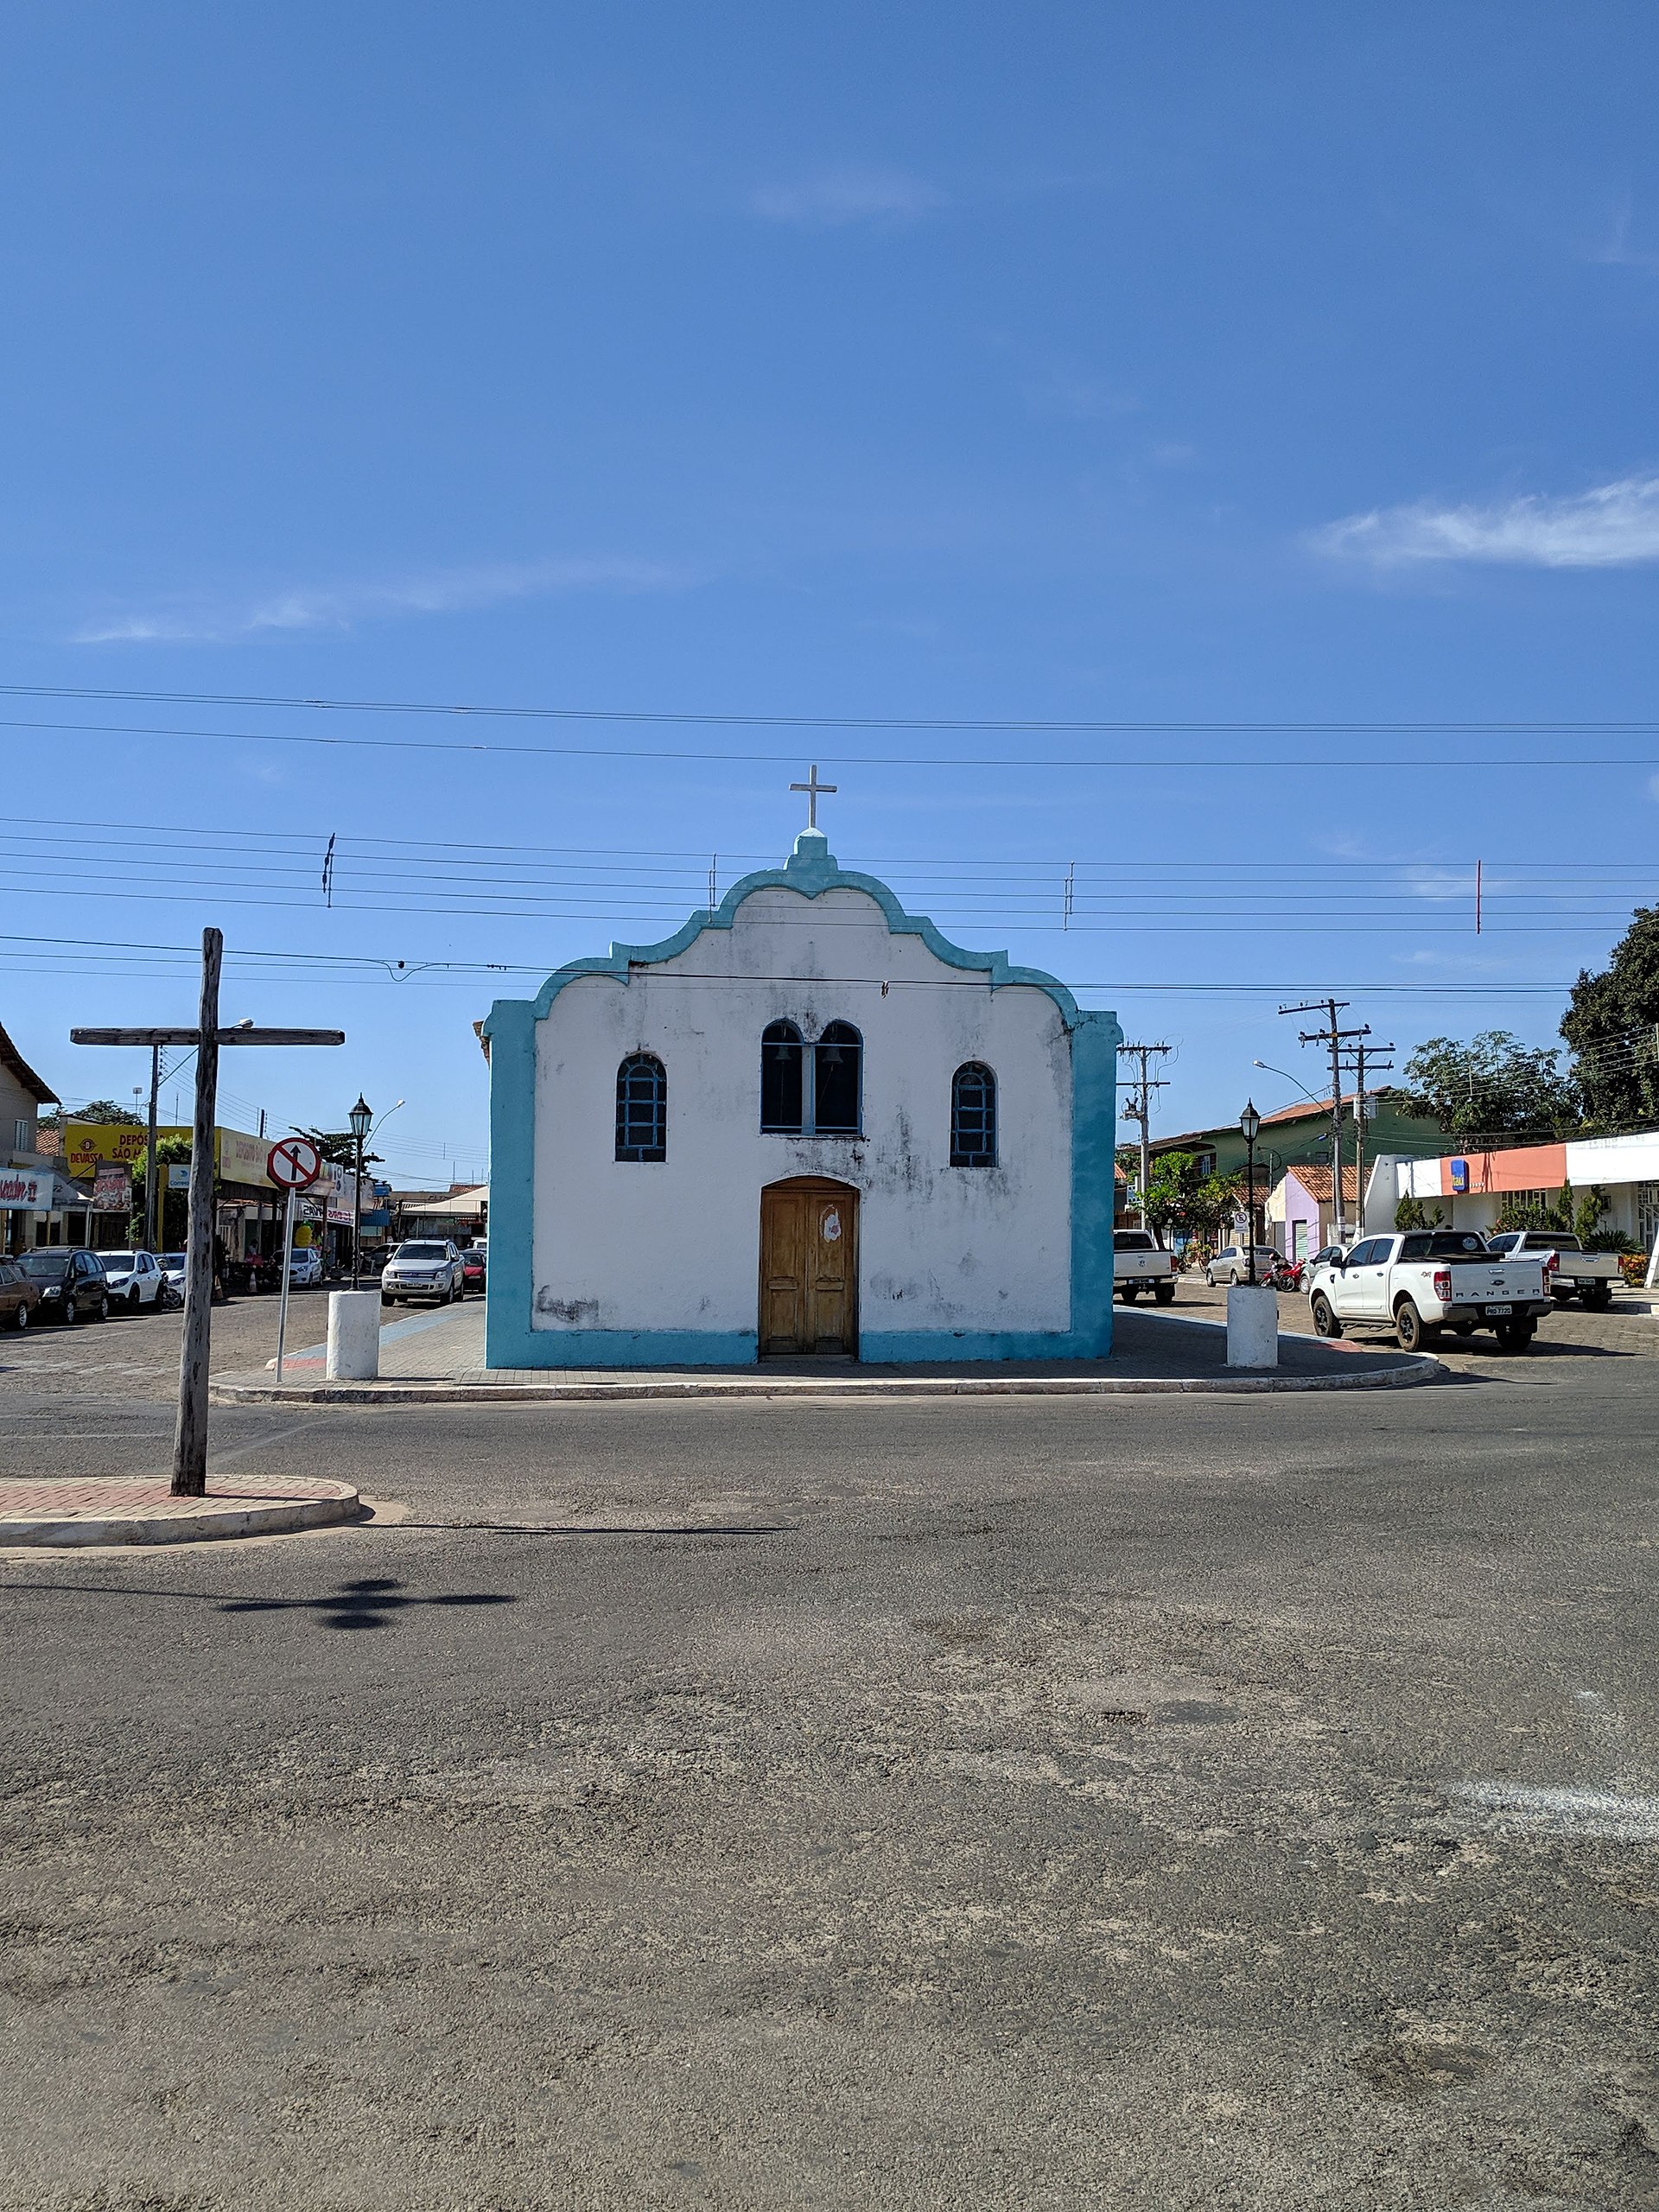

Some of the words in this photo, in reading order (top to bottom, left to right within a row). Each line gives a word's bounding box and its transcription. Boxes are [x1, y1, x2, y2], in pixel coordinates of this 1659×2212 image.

[111, 1145, 131, 1159] SÃO
[70, 1153, 103, 1164] DEVASSA
[1452, 1174, 1464, 1186] Itaú
[1455, 1288, 1540, 1298] RANGER
